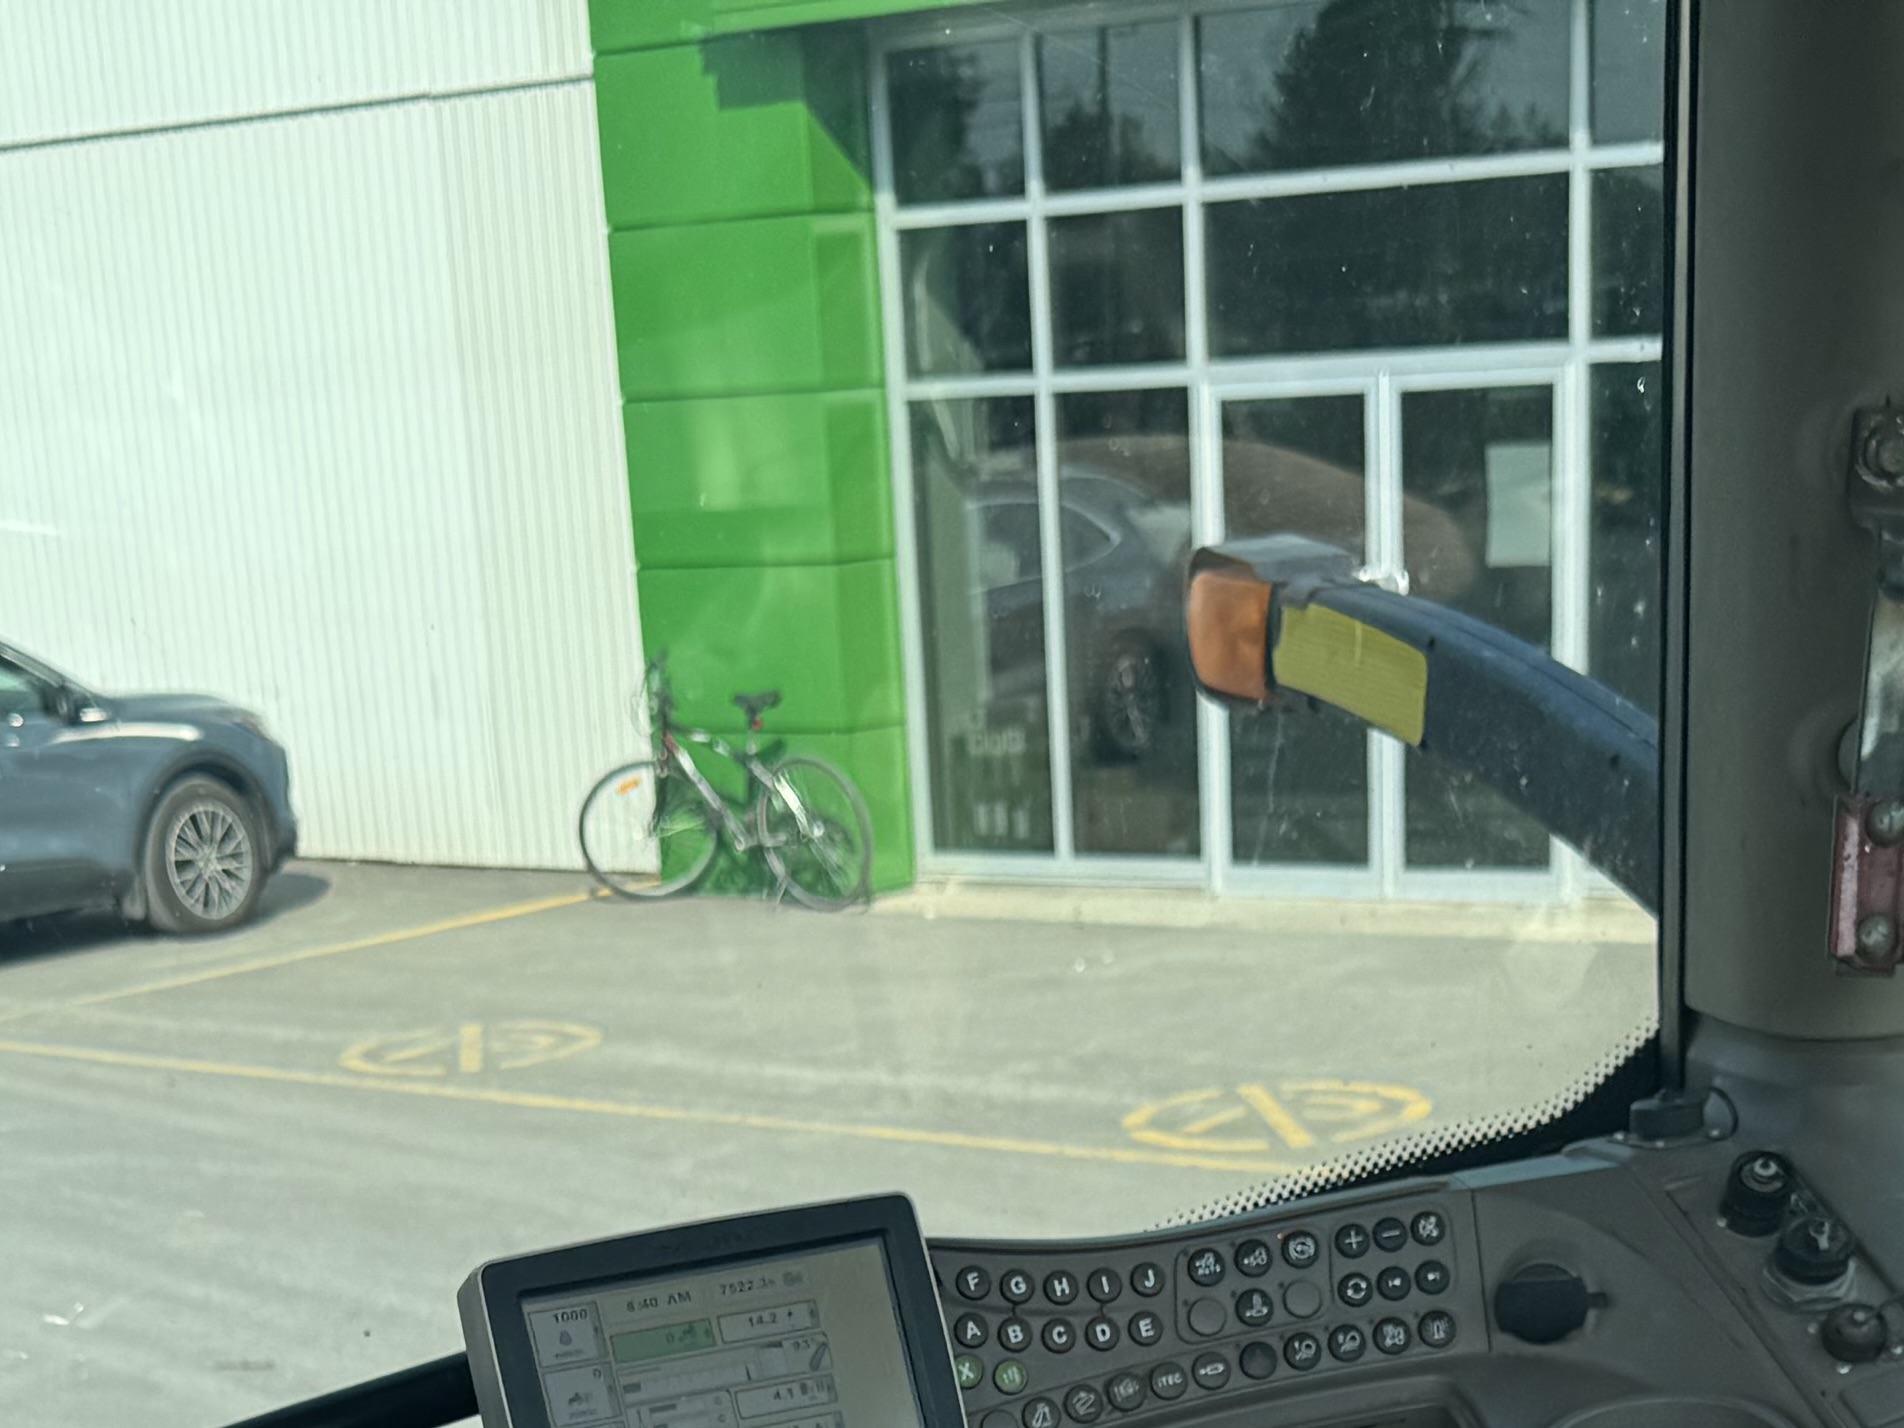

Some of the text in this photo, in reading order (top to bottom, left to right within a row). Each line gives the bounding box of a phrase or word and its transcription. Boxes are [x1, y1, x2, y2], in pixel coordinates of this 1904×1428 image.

[966, 1269, 1155, 1297] F G H I J
[552, 1308, 588, 1324] 1000
[966, 1318, 1155, 1344] A B C D E
